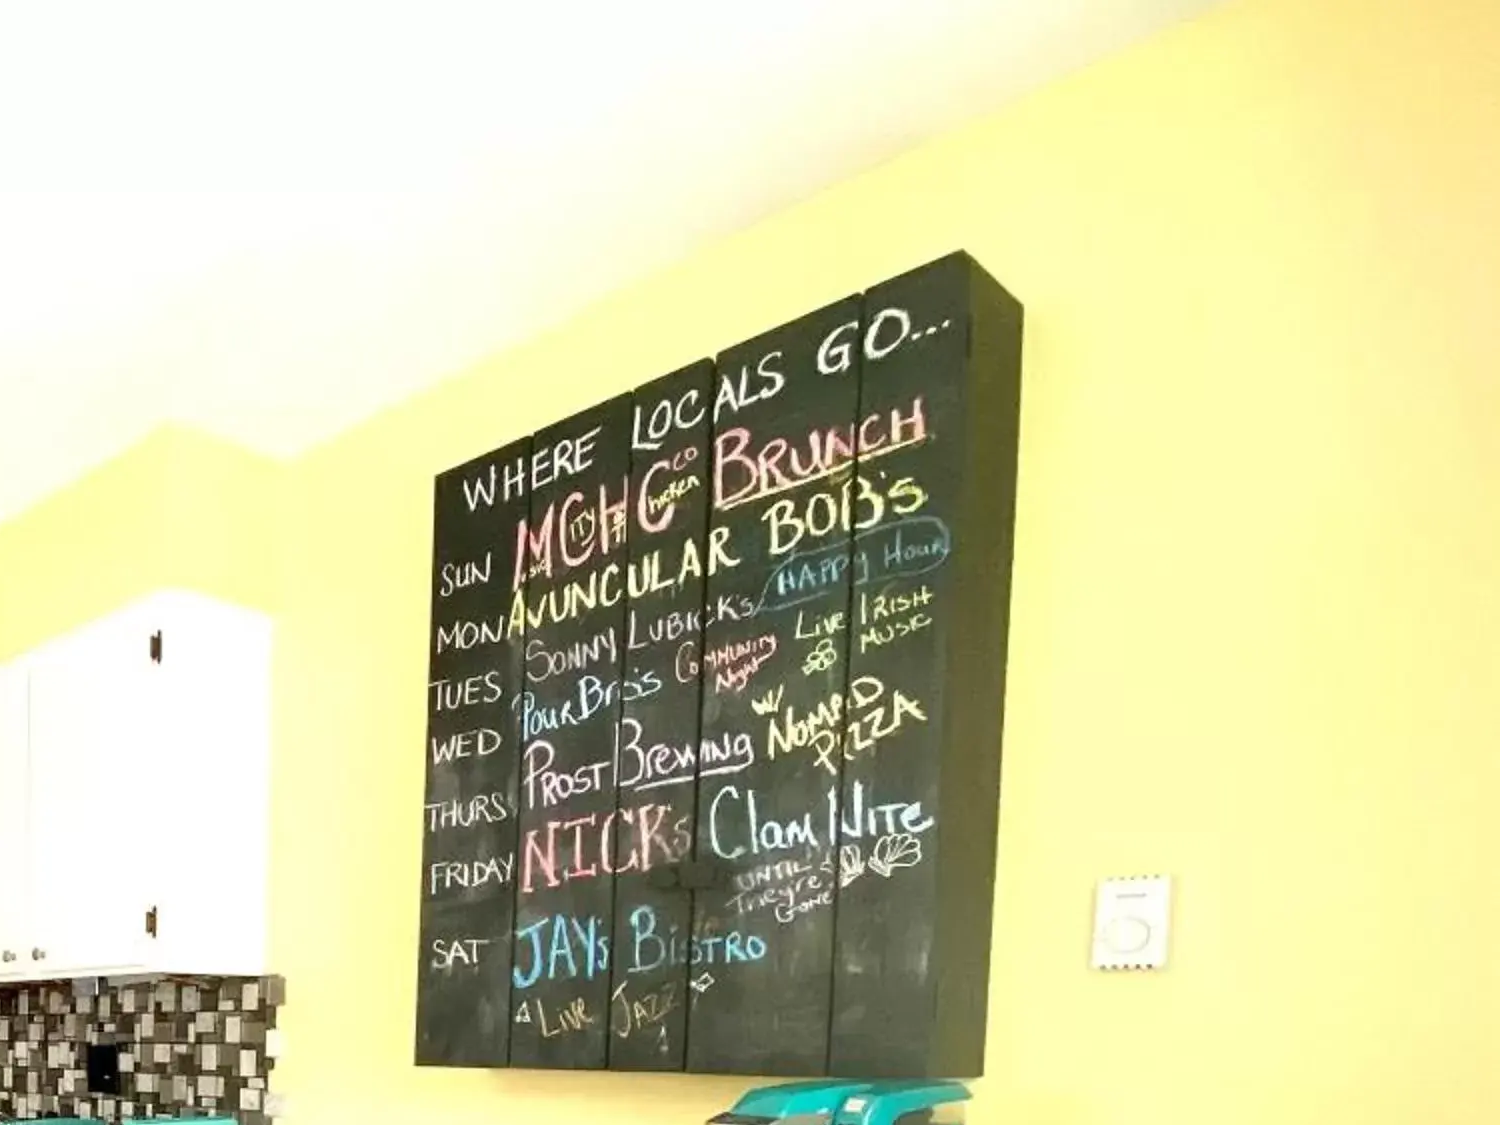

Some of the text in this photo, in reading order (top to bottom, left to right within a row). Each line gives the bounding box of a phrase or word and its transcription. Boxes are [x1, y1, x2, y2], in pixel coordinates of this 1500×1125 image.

[463, 426, 602, 511] WHERE
[631, 351, 784, 450] LOCALS
[440, 551, 492, 597] SUN
[713, 396, 927, 510] BRUNCH
[437, 614, 505, 655] MON
[507, 526, 741, 640] AVUNCULAR
[526, 626, 617, 683] SONNY
[428, 670, 503, 711] TUES
[431, 727, 501, 766] WED
[424, 791, 508, 833] THURS
[431, 852, 514, 895] FRIDAY
[432, 938, 490, 972] SAT
